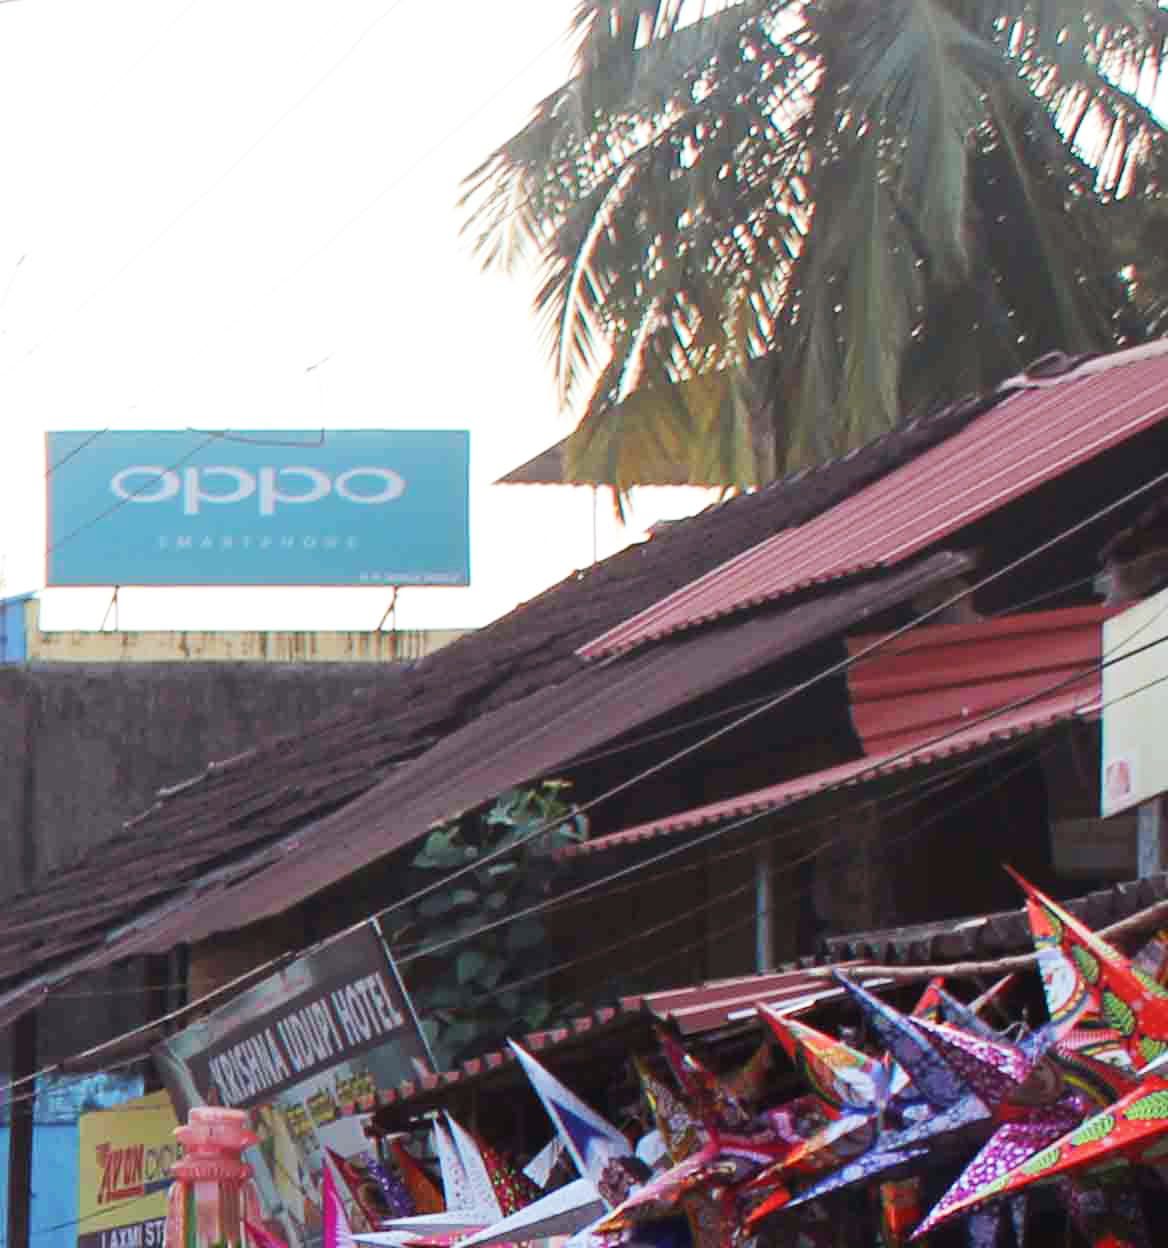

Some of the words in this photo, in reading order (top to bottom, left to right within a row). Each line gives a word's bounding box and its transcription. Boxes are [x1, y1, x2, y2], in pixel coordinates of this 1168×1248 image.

[208, 1028, 292, 1108] KRISHNA
[276, 997, 345, 1074] UDUPI
[331, 971, 403, 1047] HOTEL
